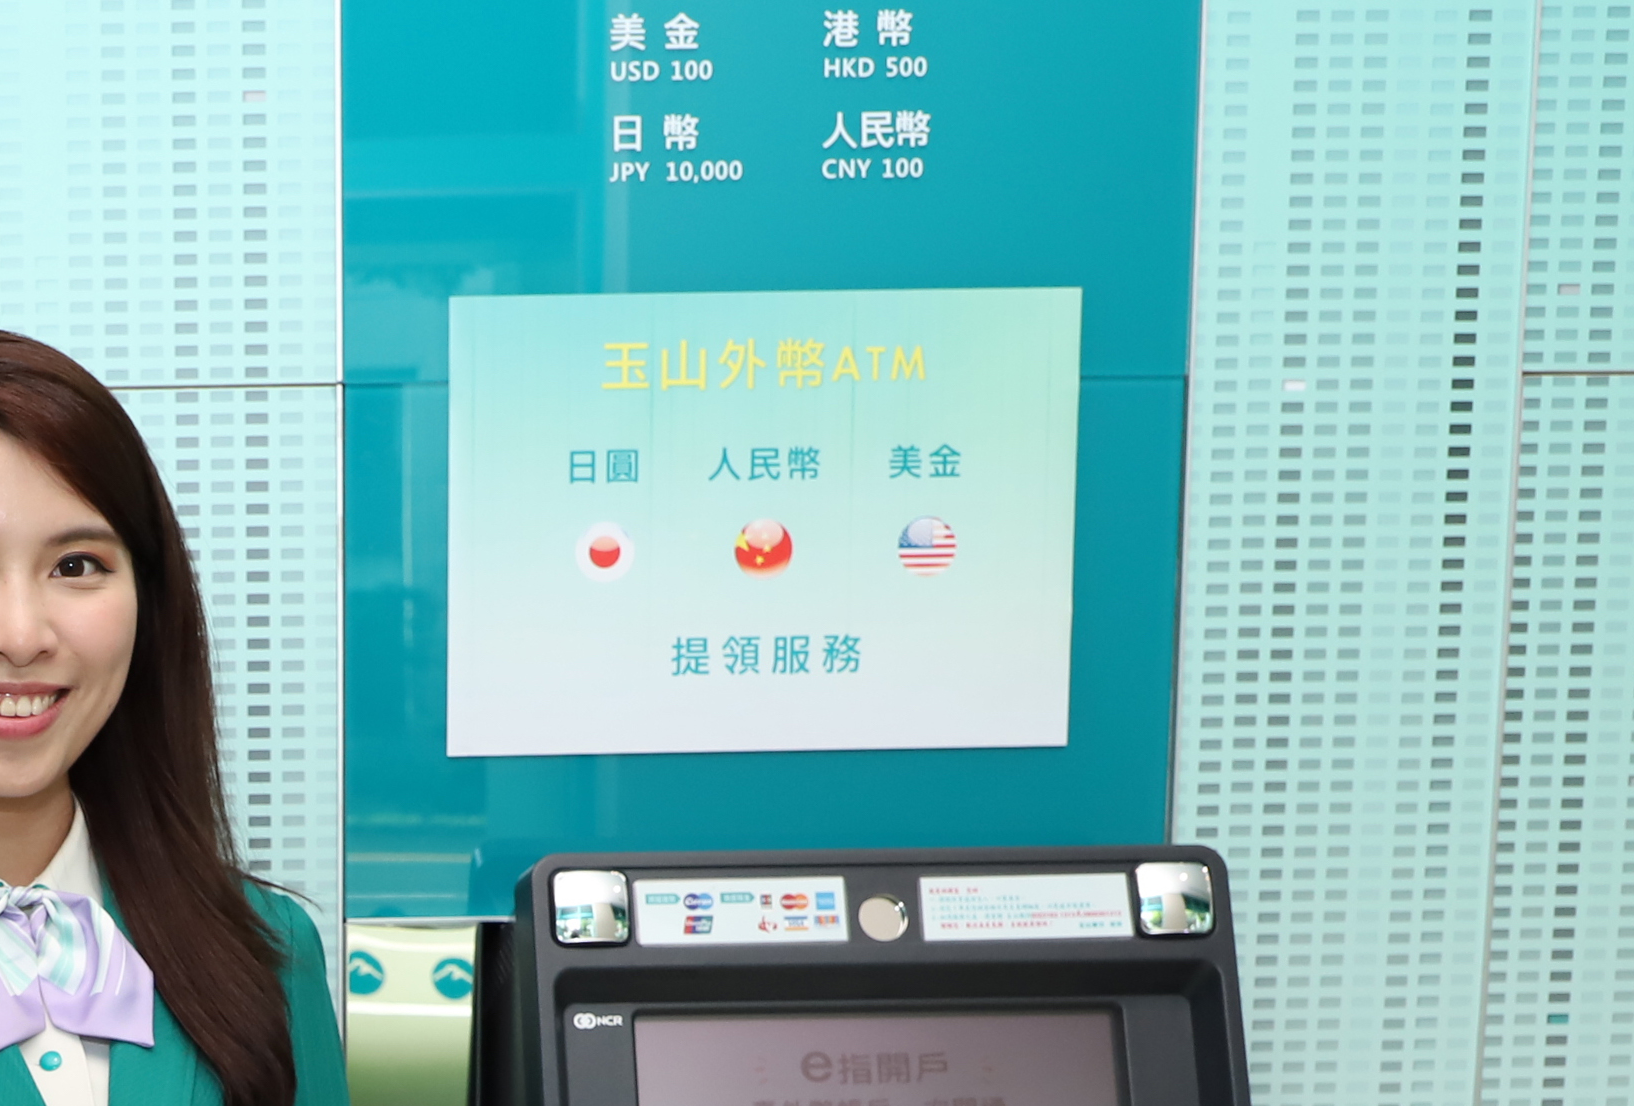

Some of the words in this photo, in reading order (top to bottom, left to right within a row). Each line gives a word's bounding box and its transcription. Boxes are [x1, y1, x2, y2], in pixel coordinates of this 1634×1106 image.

[609, 13, 700, 52] 美金
[822, 9, 913, 49] 港幣
[610, 60, 660, 82] USD
[670, 59, 714, 82] 100
[822, 57, 875, 79] HKD
[885, 56, 928, 78] 500
[612, 114, 700, 152] 日幣
[822, 110, 931, 150] 人民幣
[609, 161, 650, 183] JPY
[665, 160, 743, 184] 10,000
[822, 158, 872, 180] CNY
[881, 158, 924, 180] 100
[601, 337, 927, 392] 玉山外幣ATM
[568, 449, 640, 485] 日圓
[707, 446, 822, 482] 人民幣
[888, 444, 962, 480] 美金
[670, 633, 863, 677] 提領服務
[596, 1014, 623, 1027] NCR
[800, 1051, 949, 1086] e指開戶
